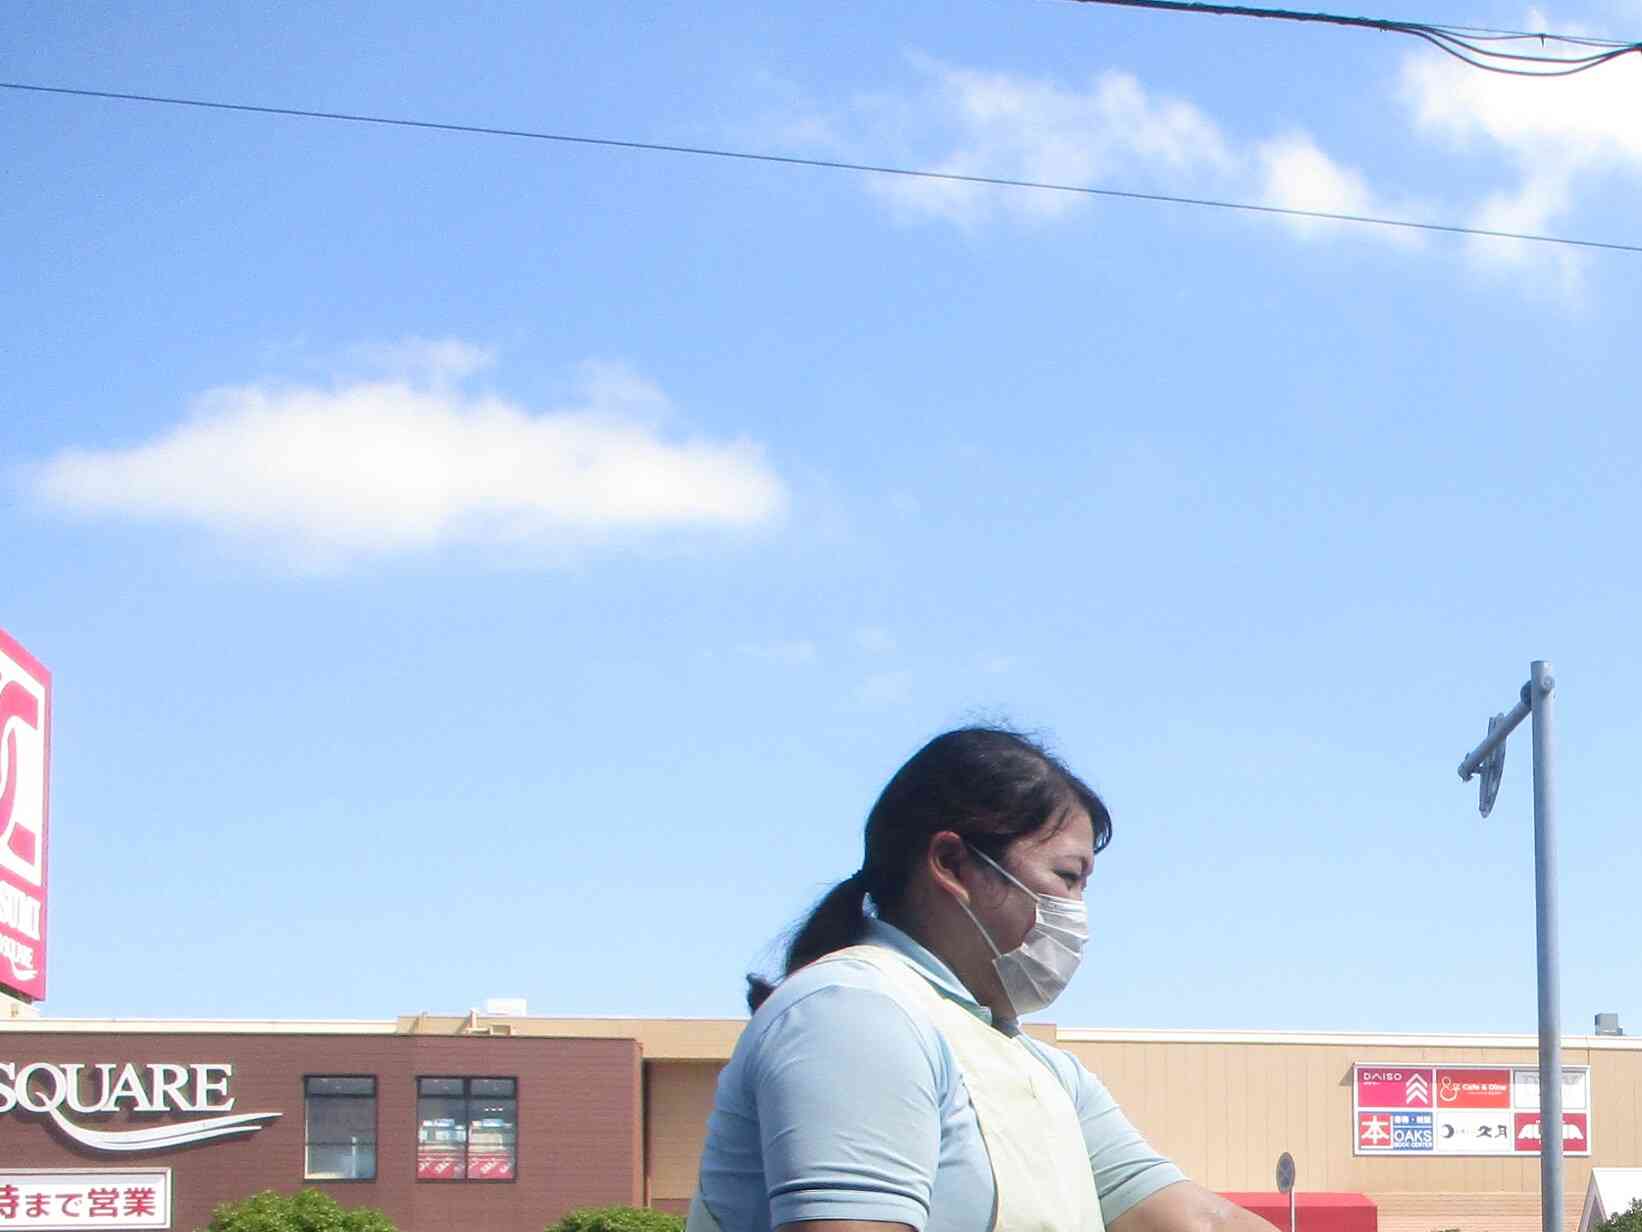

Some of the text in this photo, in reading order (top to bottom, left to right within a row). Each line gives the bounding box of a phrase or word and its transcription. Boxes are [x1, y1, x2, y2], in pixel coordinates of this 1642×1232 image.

[1363, 1072, 1402, 1081] DAISO
[0, 1062, 250, 1124] SQUARE
[1361, 1114, 1390, 1145] 本
[1394, 1129, 1433, 1144] OAKS
